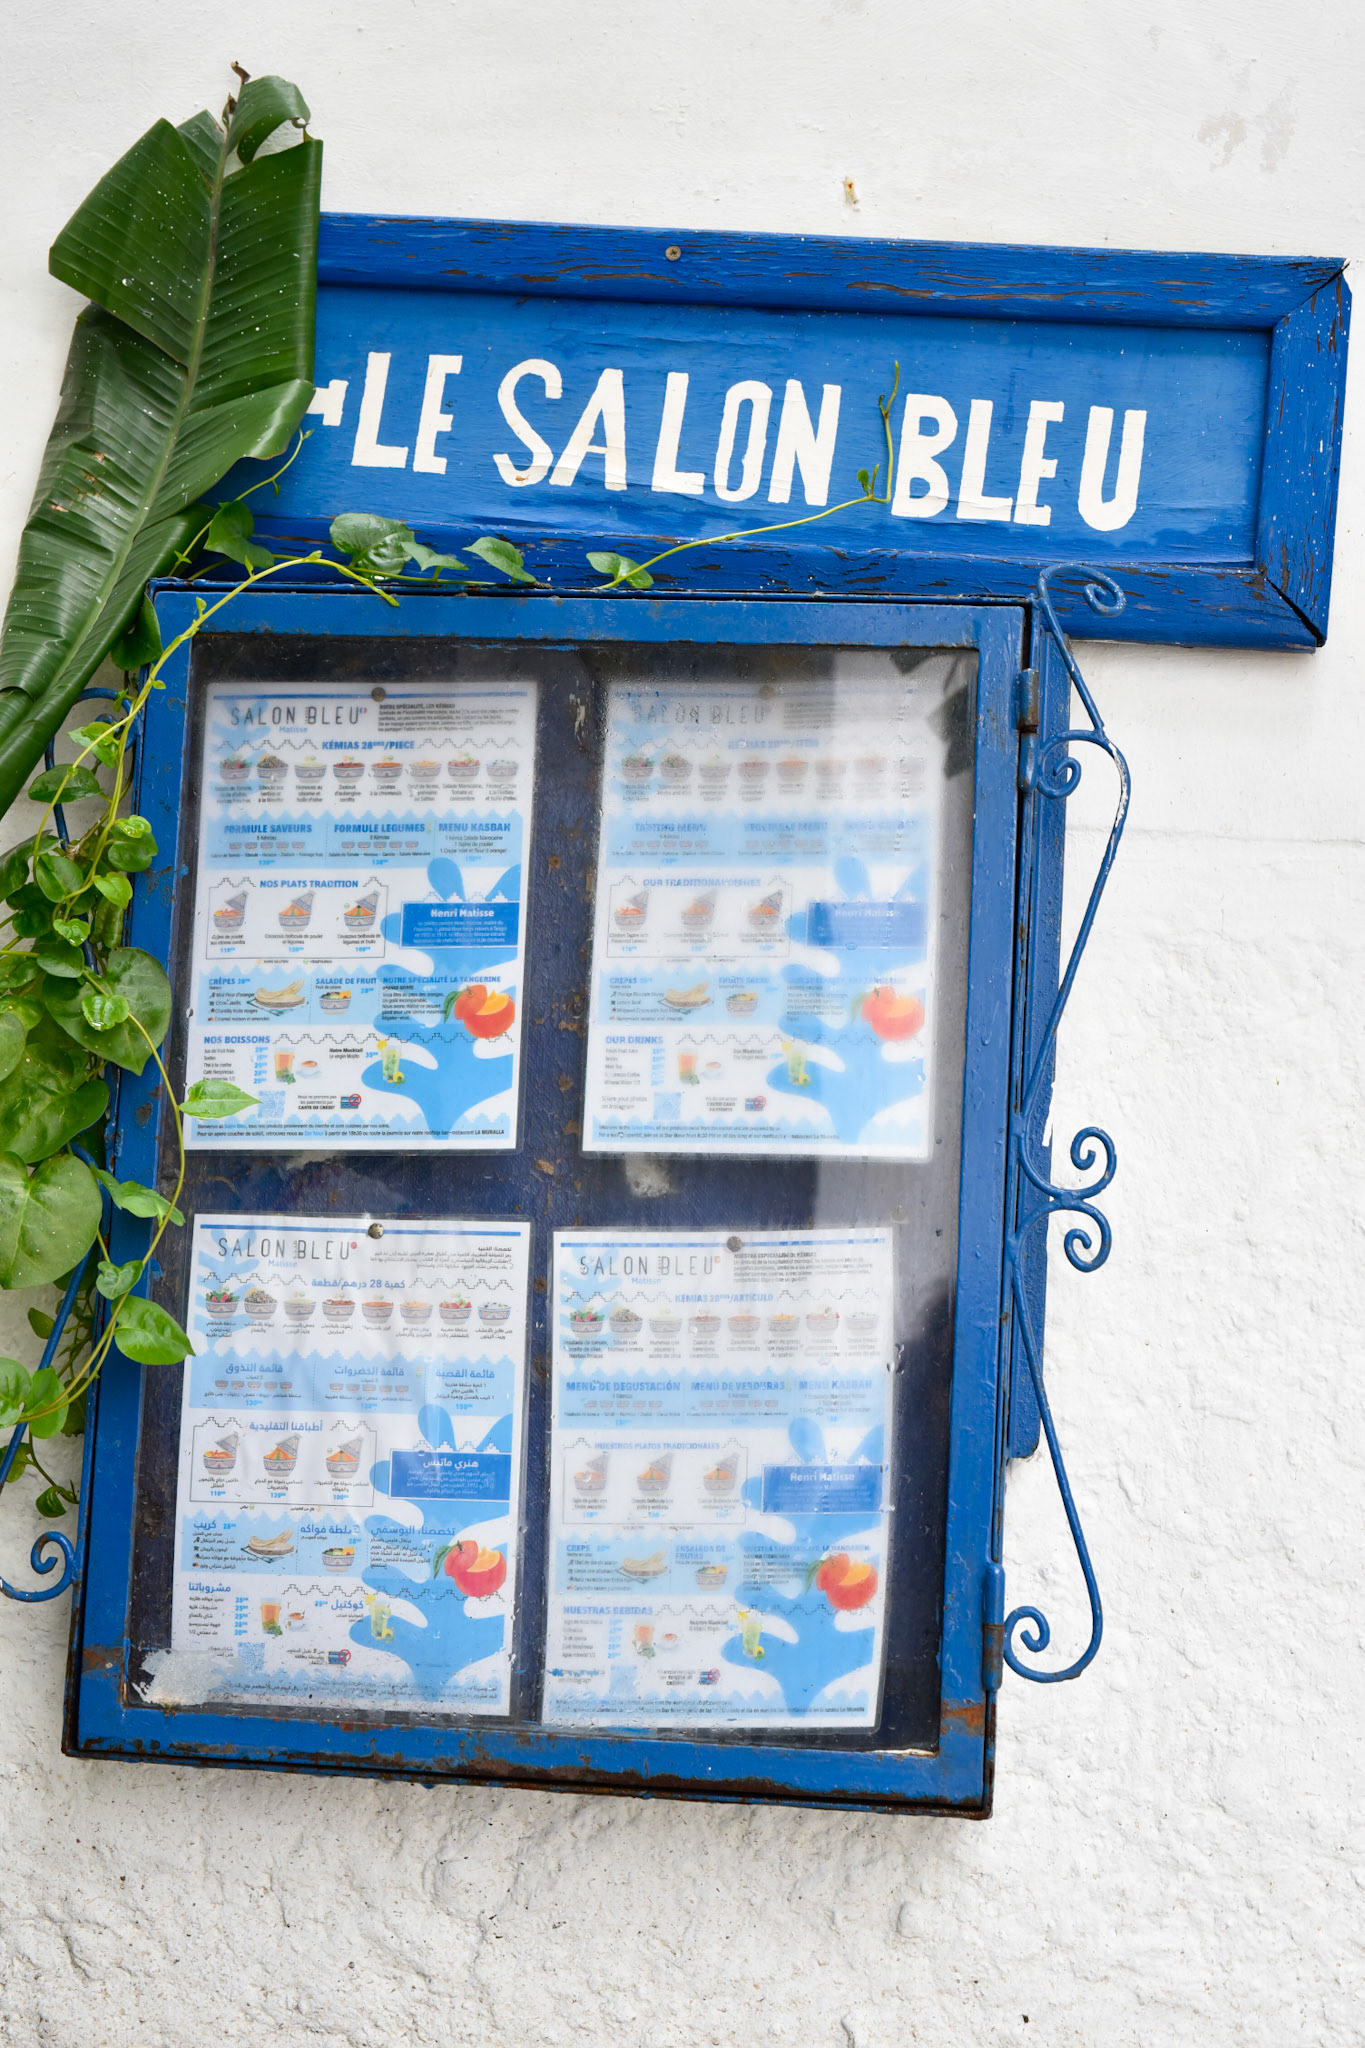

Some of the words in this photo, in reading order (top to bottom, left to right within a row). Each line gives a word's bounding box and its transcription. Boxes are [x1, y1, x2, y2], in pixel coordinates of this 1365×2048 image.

[351, 352, 462, 473] LE
[493, 358, 841, 506] SALON
[892, 393, 1147, 531] BLEU
[230, 706, 296, 726] SALON
[307, 706, 360, 725] BLEU
[322, 739, 359, 751] KÉMIAS
[224, 824, 268, 834] FORMULE
[270, 824, 312, 833] SAVEURS
[334, 824, 378, 833] FORMULE
[381, 823, 425, 833] LEGUMES
[438, 823, 468, 832] MENU
[470, 822, 511, 832] KASBAH
[260, 880, 279, 888] NOS
[280, 880, 308, 888] PLATS
[310, 879, 359, 888] TRADITION
[430, 908, 458, 917] Henri
[459, 908, 495, 917] Matisse
[209, 976, 236, 985] CRÊPES
[315, 977, 343, 985] SALADE
[356, 976, 377, 985] FRUIT
[382, 976, 406, 984] NOTRE
[407, 975, 448, 984] SPÉCIALITÉ
[460, 975, 501, 983] TANGERINE
[204, 1036, 222, 1044] NOS
[225, 1036, 270, 1044] BOISSONS
[605, 1036, 626, 1044] OUR
[627, 1036, 664, 1044] DRINKS
[218, 1237, 285, 1258] SALON
[297, 1239, 350, 1260] BLEU
[580, 1255, 648, 1276] SALON
[661, 1255, 713, 1276] BLEU
[369, 1279, 381, 1289] 28
[384, 1279, 406, 1290] كمية
[225, 1362, 256, 1374] التذوق
[259, 1363, 283, 1373] قائمة
[380, 1366, 404, 1377] قائمة
[470, 1368, 495, 1379] قائمة
[599, 1382, 611, 1391] DE
[613, 1380, 680, 1391] DEGUSTACIÓN
[249, 1419, 289, 1431] التقليدية
[291, 1419, 323, 1432] أطباقنا
[423, 1457, 453, 1468] ماتيس
[454, 1459, 479, 1470] هنري
[193, 1519, 217, 1531] كريب
[300, 1523, 327, 1535] فواكه
[370, 1524, 415, 1537] اليوسفي
[188, 1581, 232, 1594] مشروباتنا
[330, 1599, 364, 1611] كوكتيل
